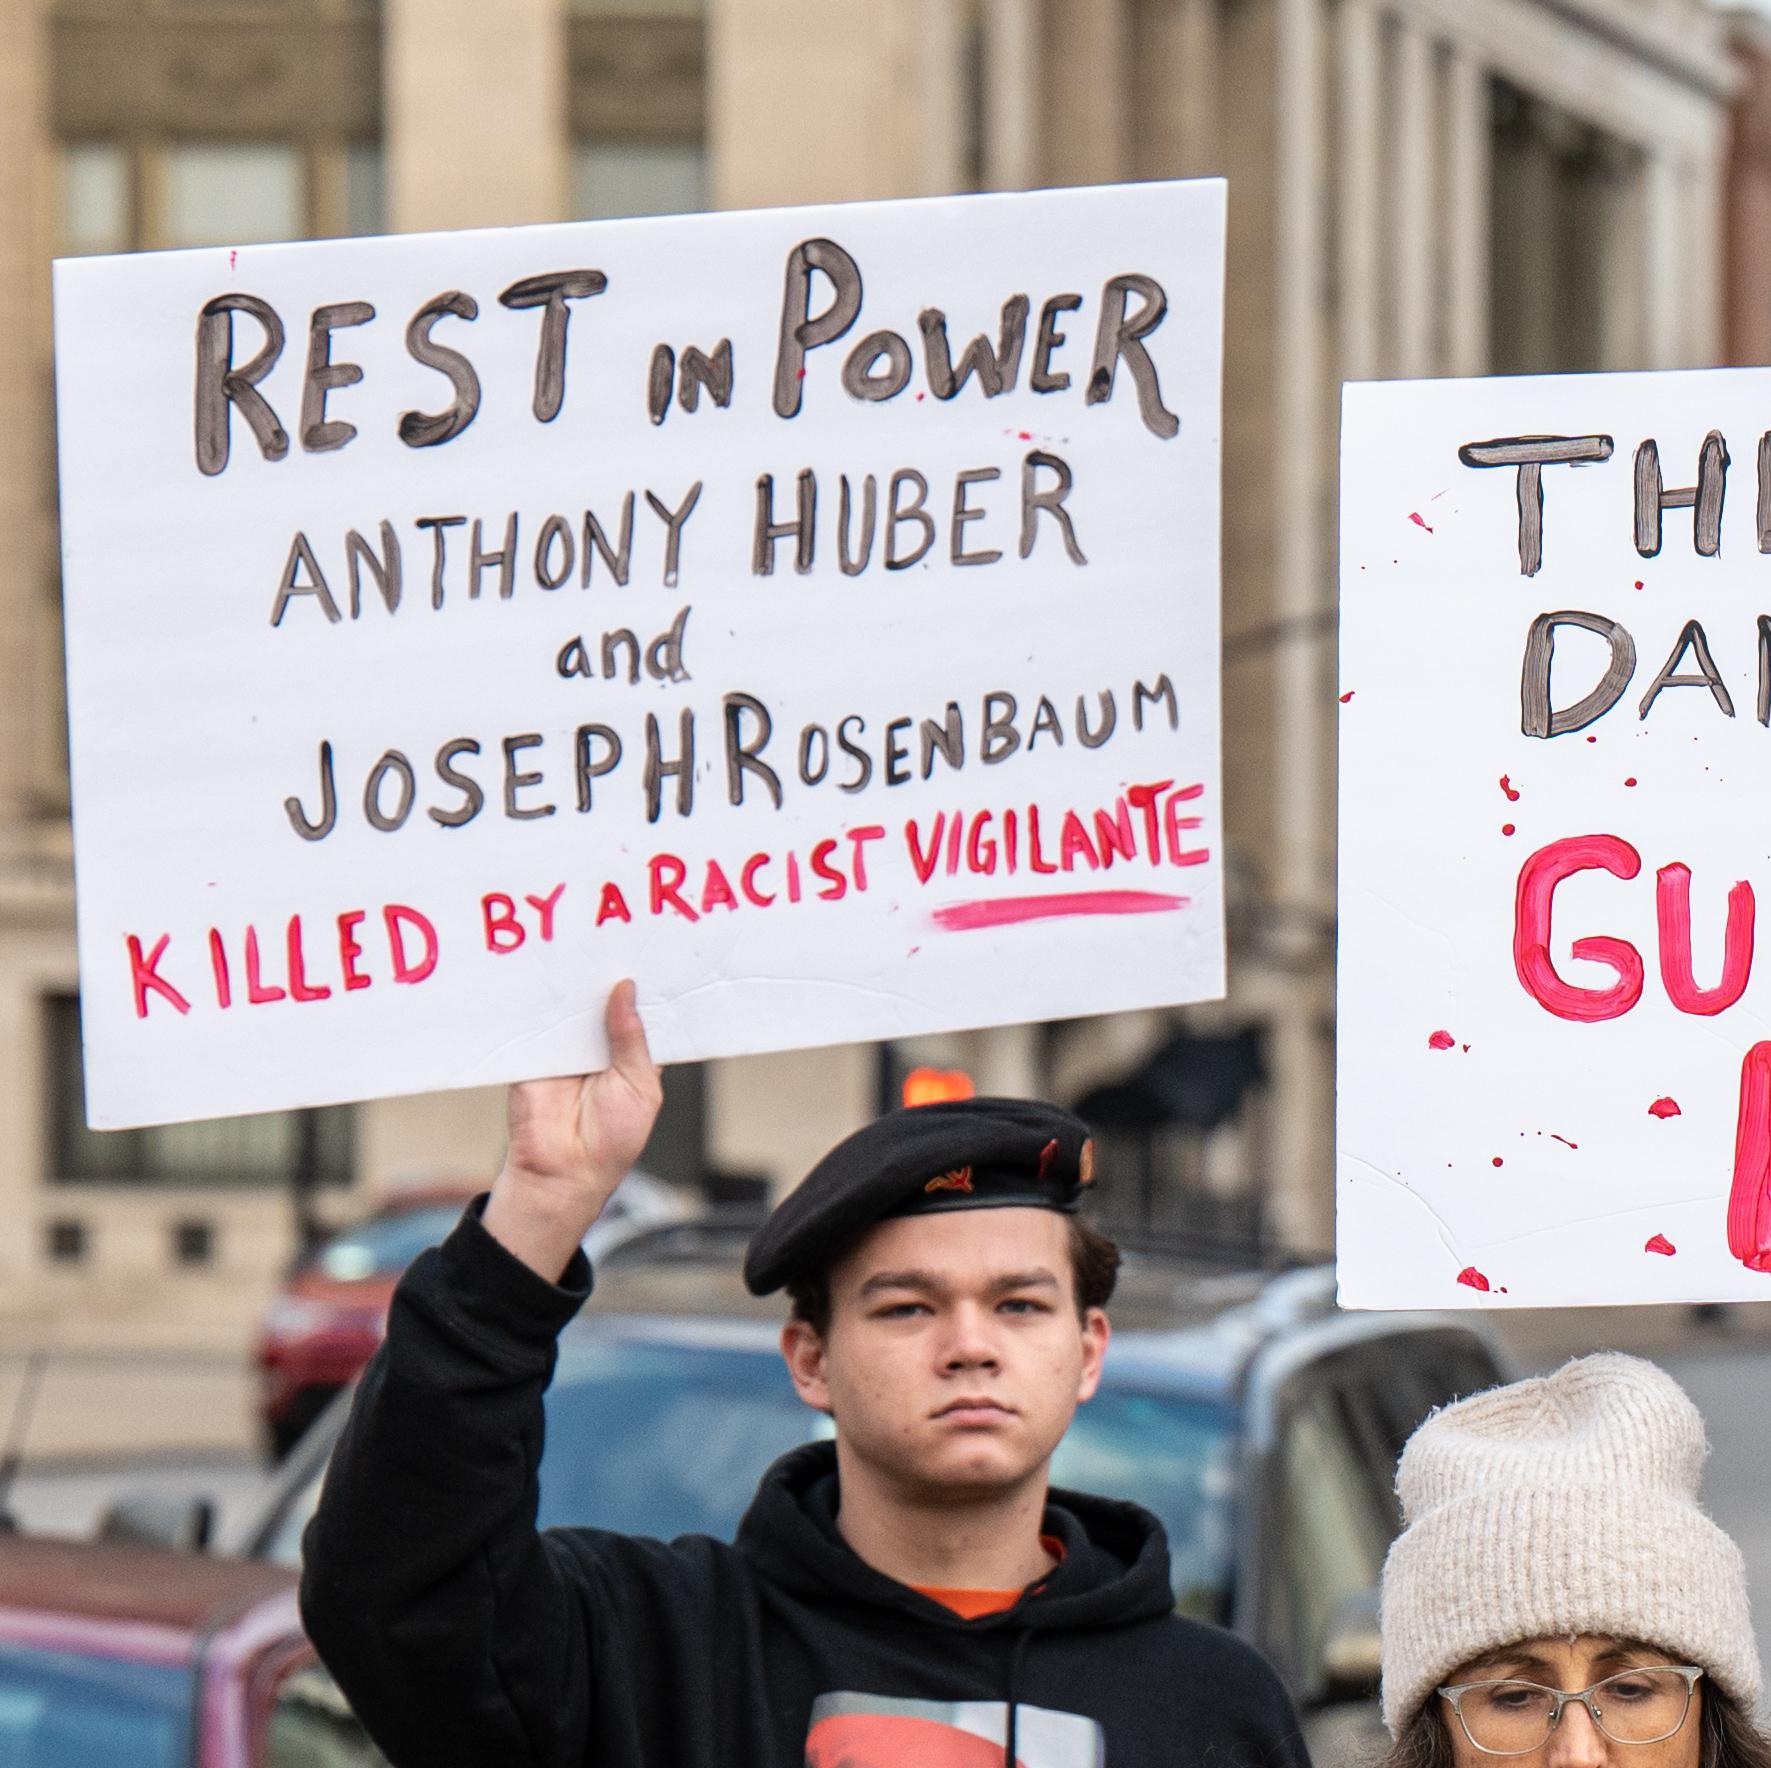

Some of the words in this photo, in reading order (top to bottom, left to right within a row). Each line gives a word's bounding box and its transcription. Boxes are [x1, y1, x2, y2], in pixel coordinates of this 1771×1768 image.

[195, 269, 608, 477] REST
[772, 237, 1180, 439] POWER
[271, 482, 702, 626] ANTHONY
[753, 449, 1086, 577] HUBER
[556, 606, 691, 684] and
[284, 708, 694, 841] JOSEPH
[724, 674, 1178, 810] ROSENBAUM
[125, 903, 440, 1020] KILLED
[481, 883, 565, 955] BY
[647, 825, 886, 923] RACIST
[904, 778, 1212, 884] VIGILANTE
